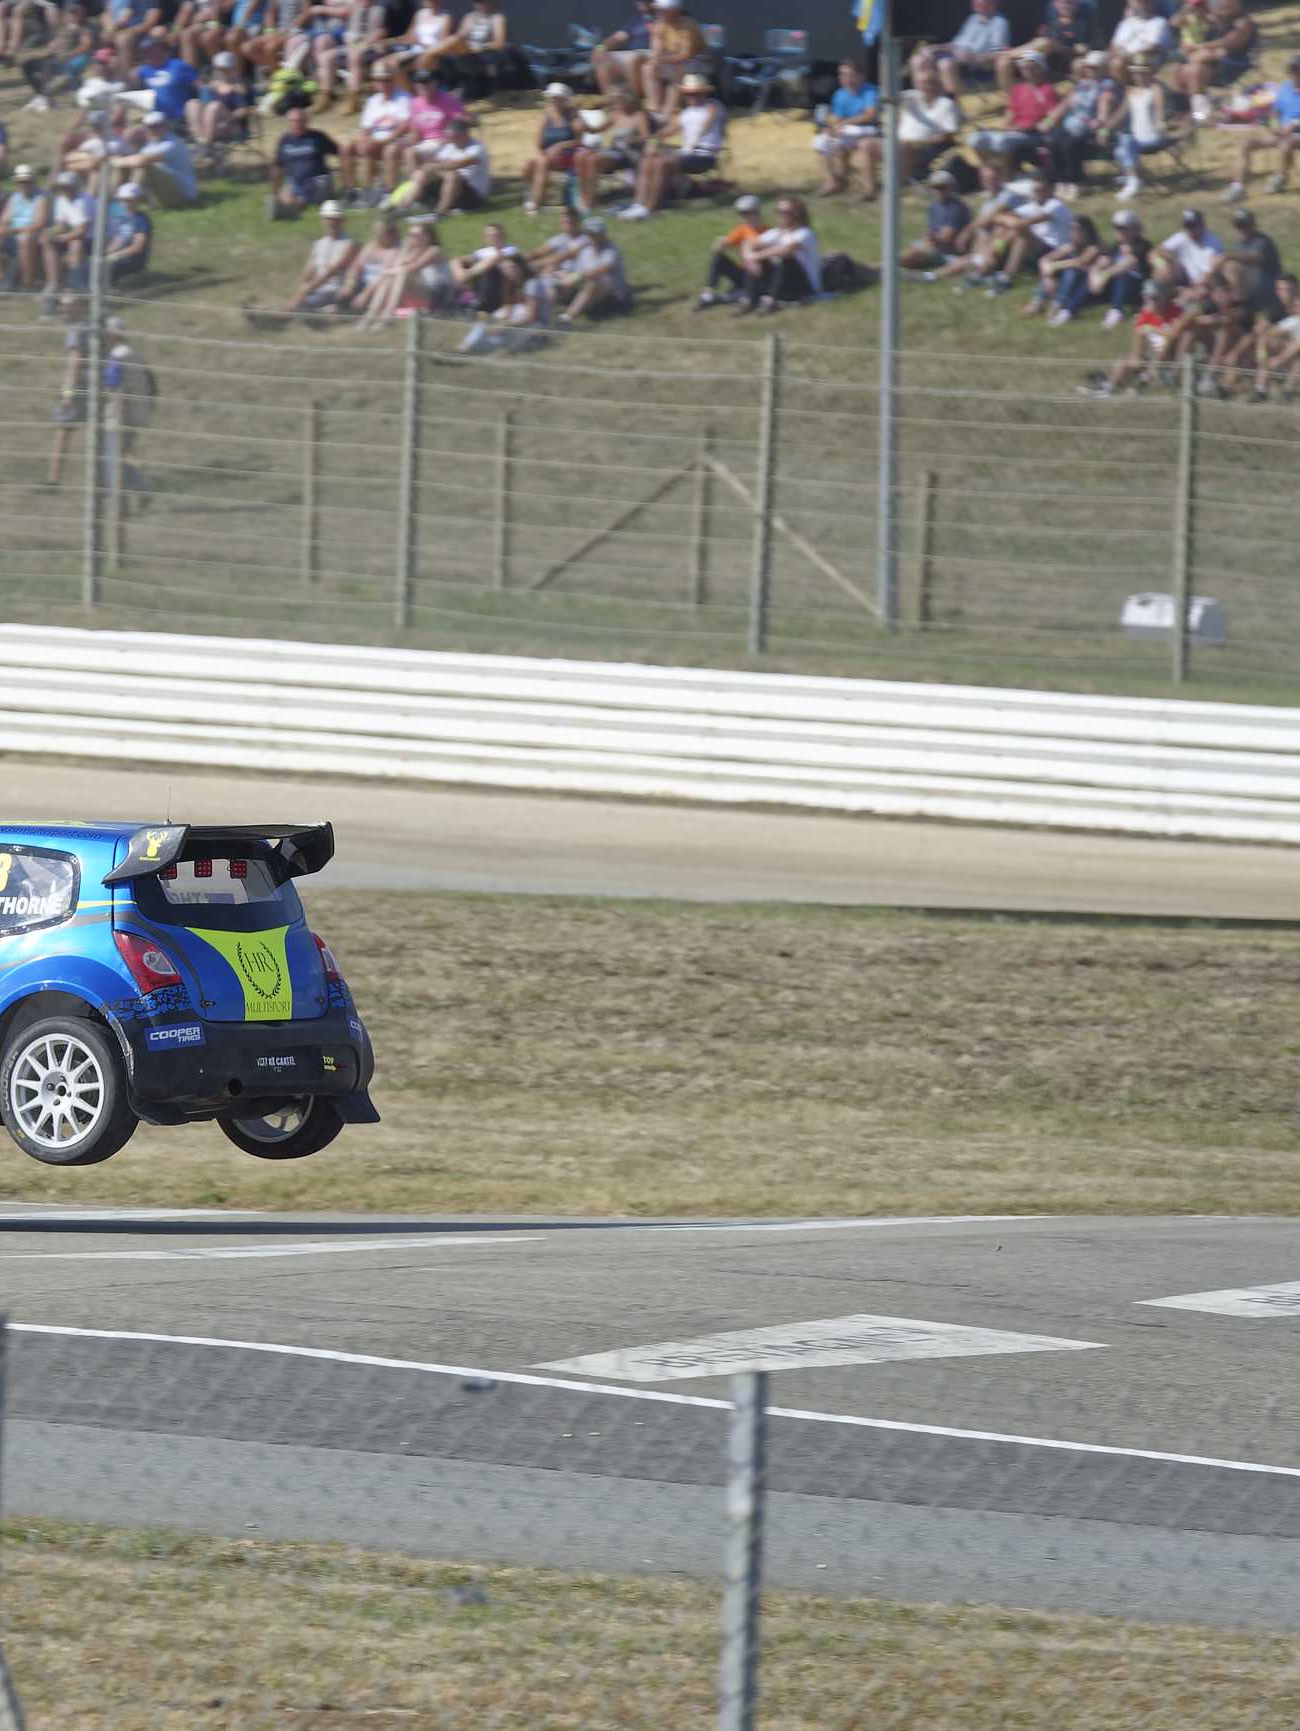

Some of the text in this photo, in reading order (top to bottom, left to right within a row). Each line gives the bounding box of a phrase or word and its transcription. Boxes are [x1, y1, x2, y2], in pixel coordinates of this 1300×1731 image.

[244, 951, 275, 973] HR
[246, 1001, 291, 1013] MULTISPORT
[150, 1026, 201, 1041] COOPER
[178, 1034, 201, 1043] TIRES
[276, 1055, 297, 1067] CARTEL
